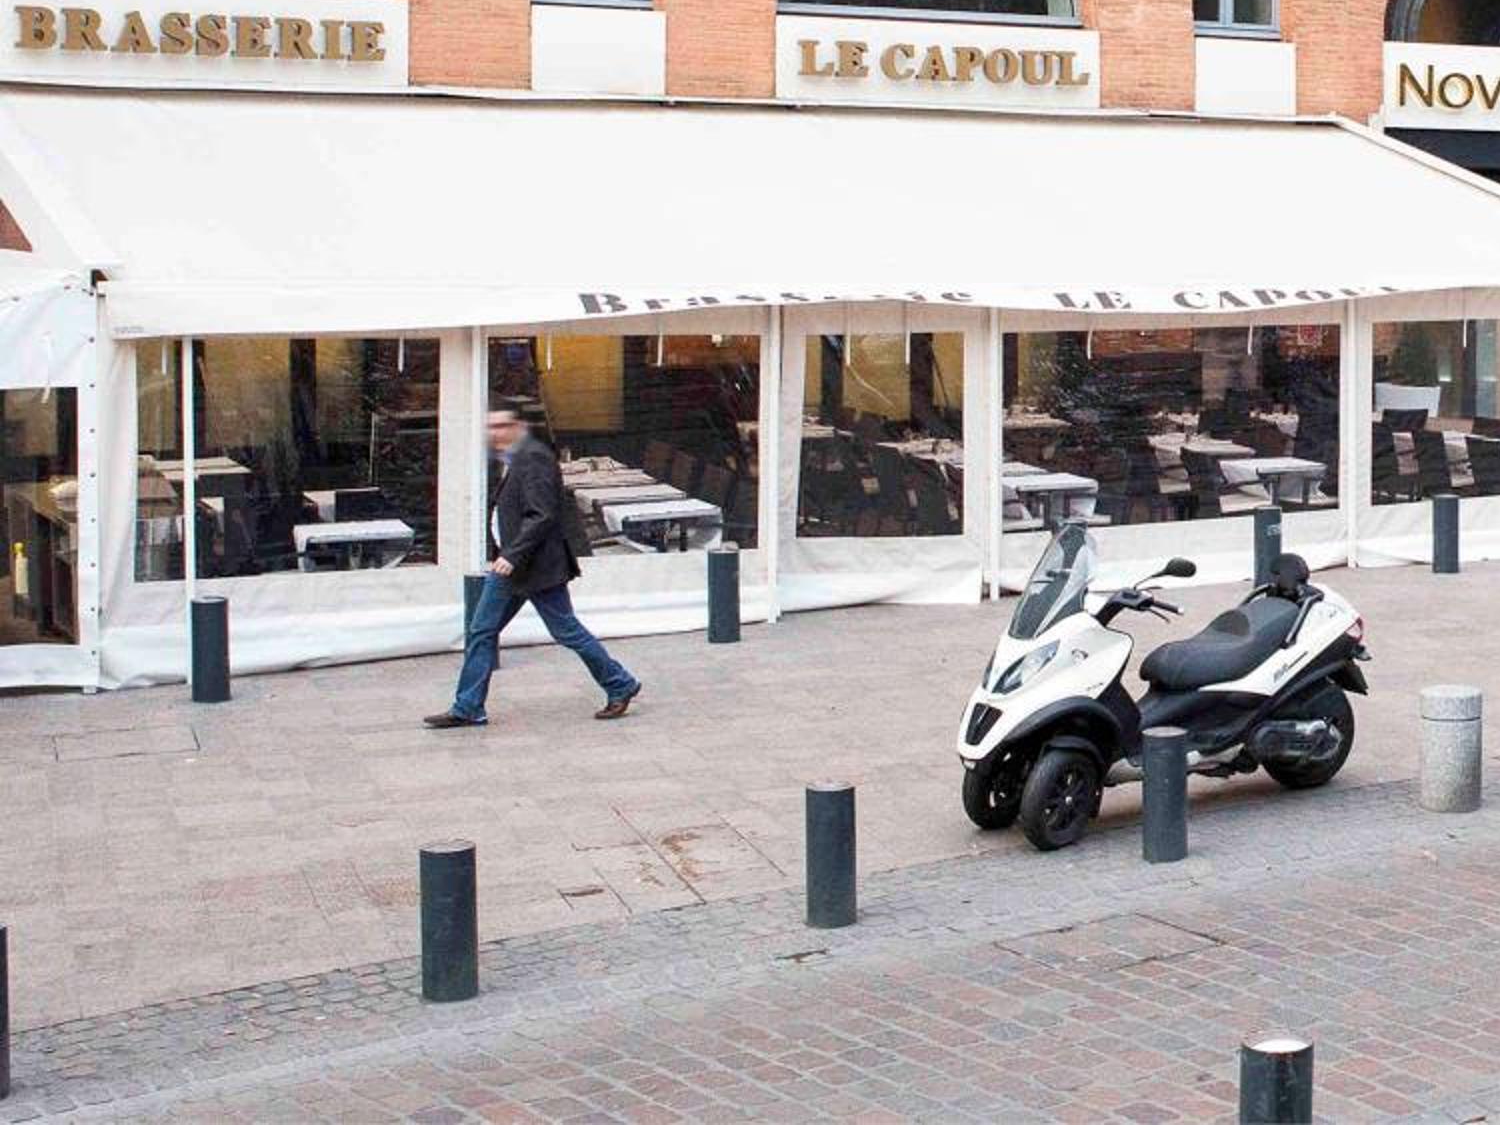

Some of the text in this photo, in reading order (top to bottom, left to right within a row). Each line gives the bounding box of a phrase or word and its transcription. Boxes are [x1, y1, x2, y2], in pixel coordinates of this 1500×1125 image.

[14, 5, 385, 62] BRASSERIE
[797, 39, 1090, 86] LE CAPOUL
[1053, 291, 1133, 310] LE
[1172, 285, 1398, 310] CAPO
